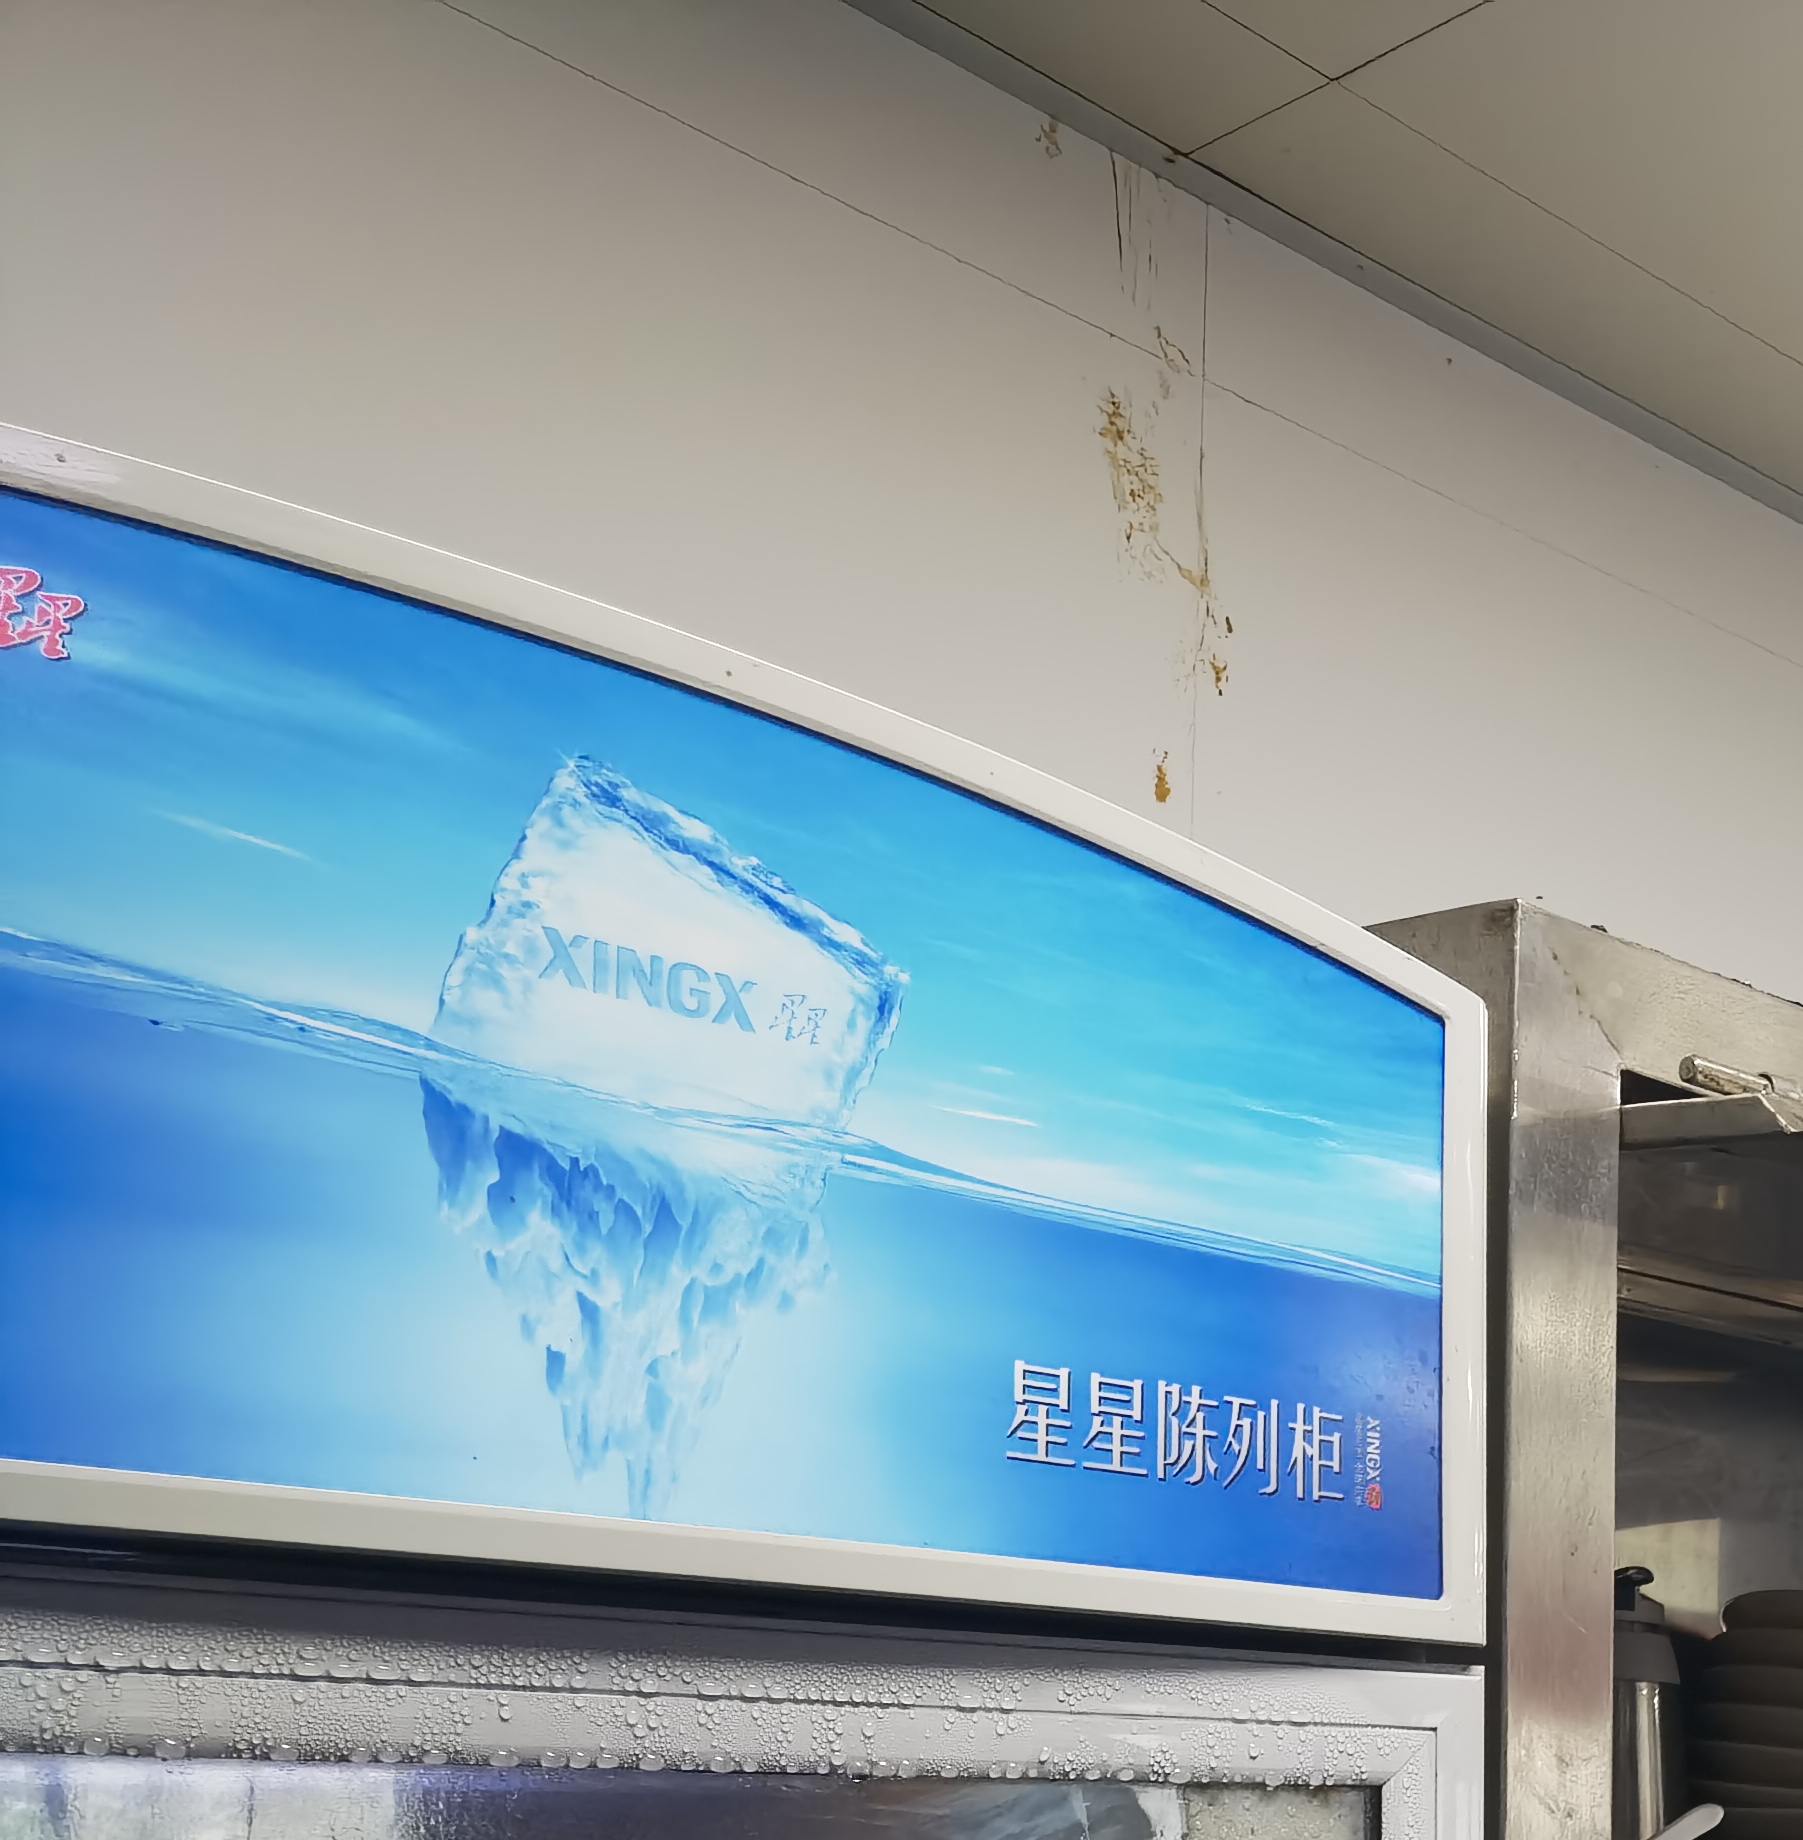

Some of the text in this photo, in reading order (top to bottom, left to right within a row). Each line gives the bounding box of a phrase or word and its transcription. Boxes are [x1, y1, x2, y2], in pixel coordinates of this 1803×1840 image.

[538, 925, 758, 1035] XINGX
[1006, 1359, 1346, 1503] 星星陈列柜
